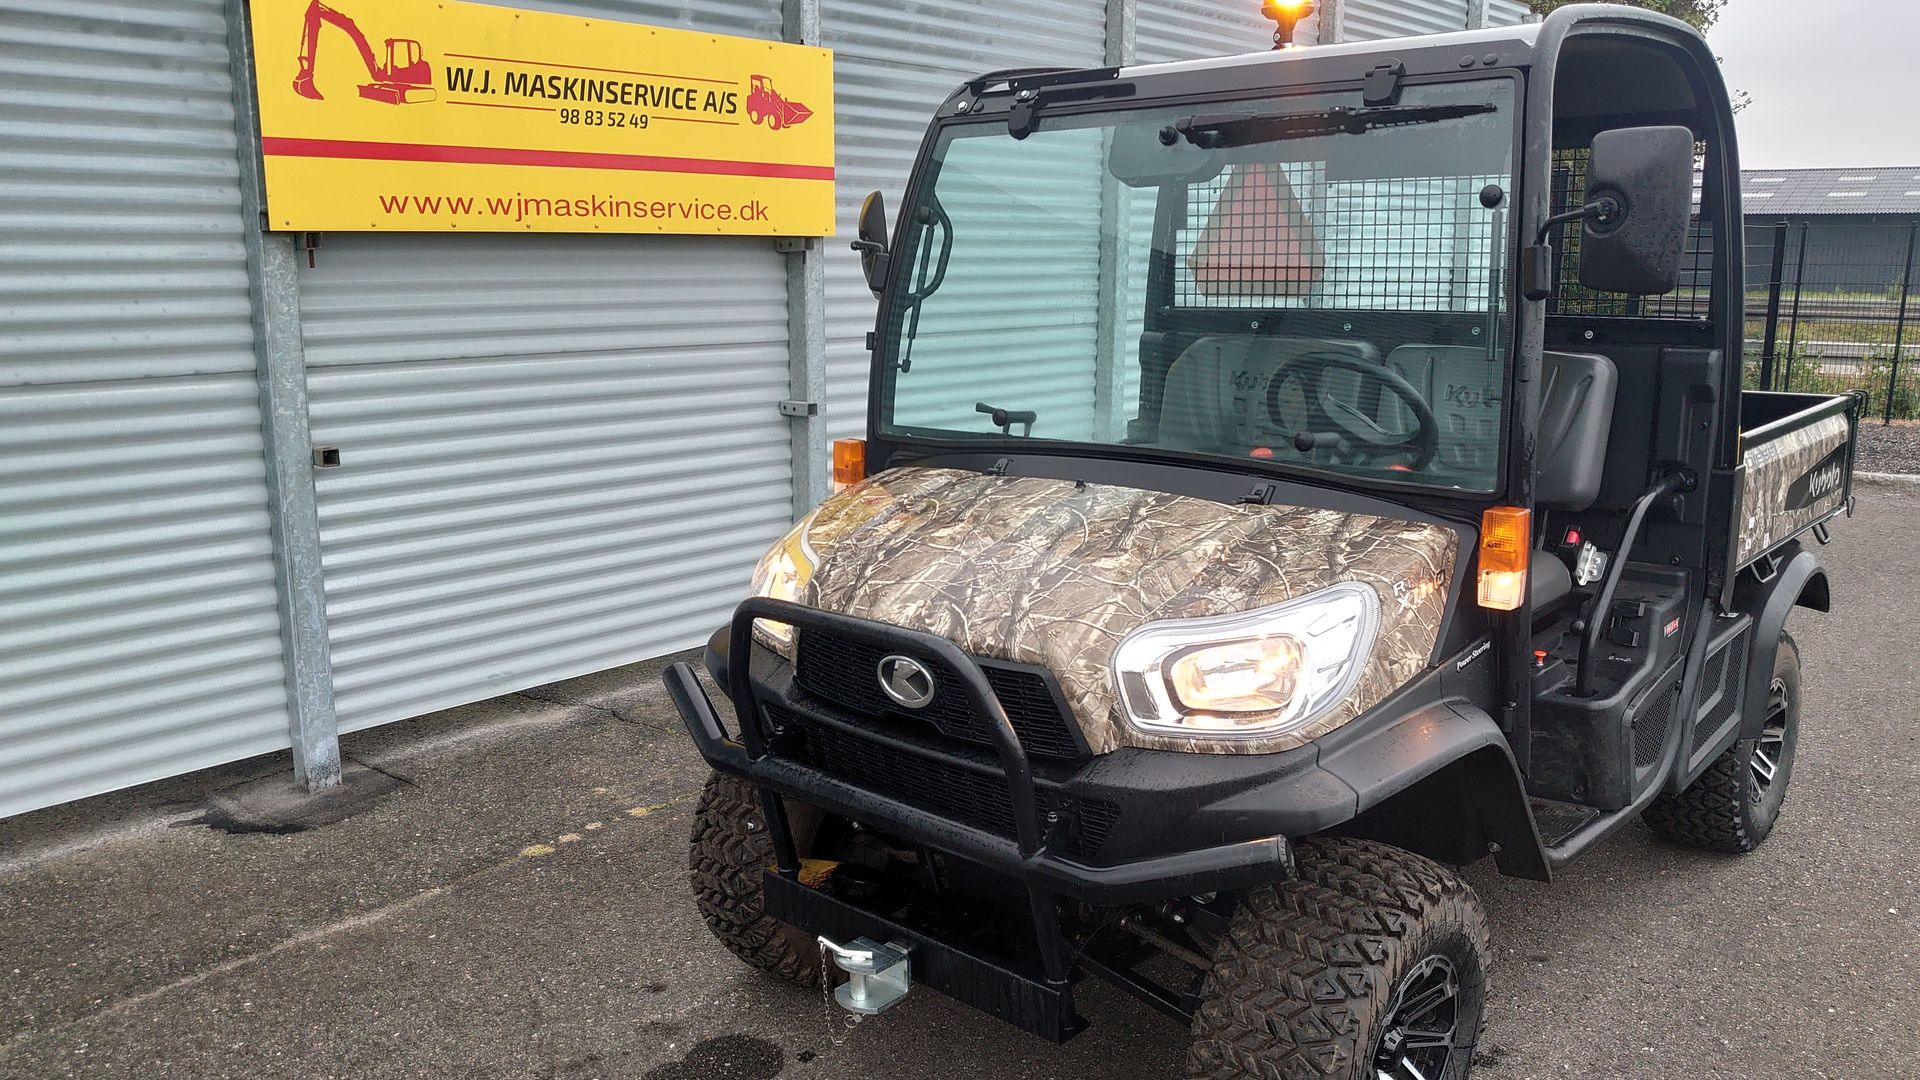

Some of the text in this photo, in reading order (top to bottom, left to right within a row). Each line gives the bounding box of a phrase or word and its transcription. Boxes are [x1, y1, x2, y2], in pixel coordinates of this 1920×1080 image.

[446, 66, 738, 115] W.J. MASKINSERVICE A/S
[560, 108, 649, 129] 98 83 52 49
[378, 192, 769, 222] www.wjmaskinservice.dk
[1808, 461, 1840, 498] Kubota
